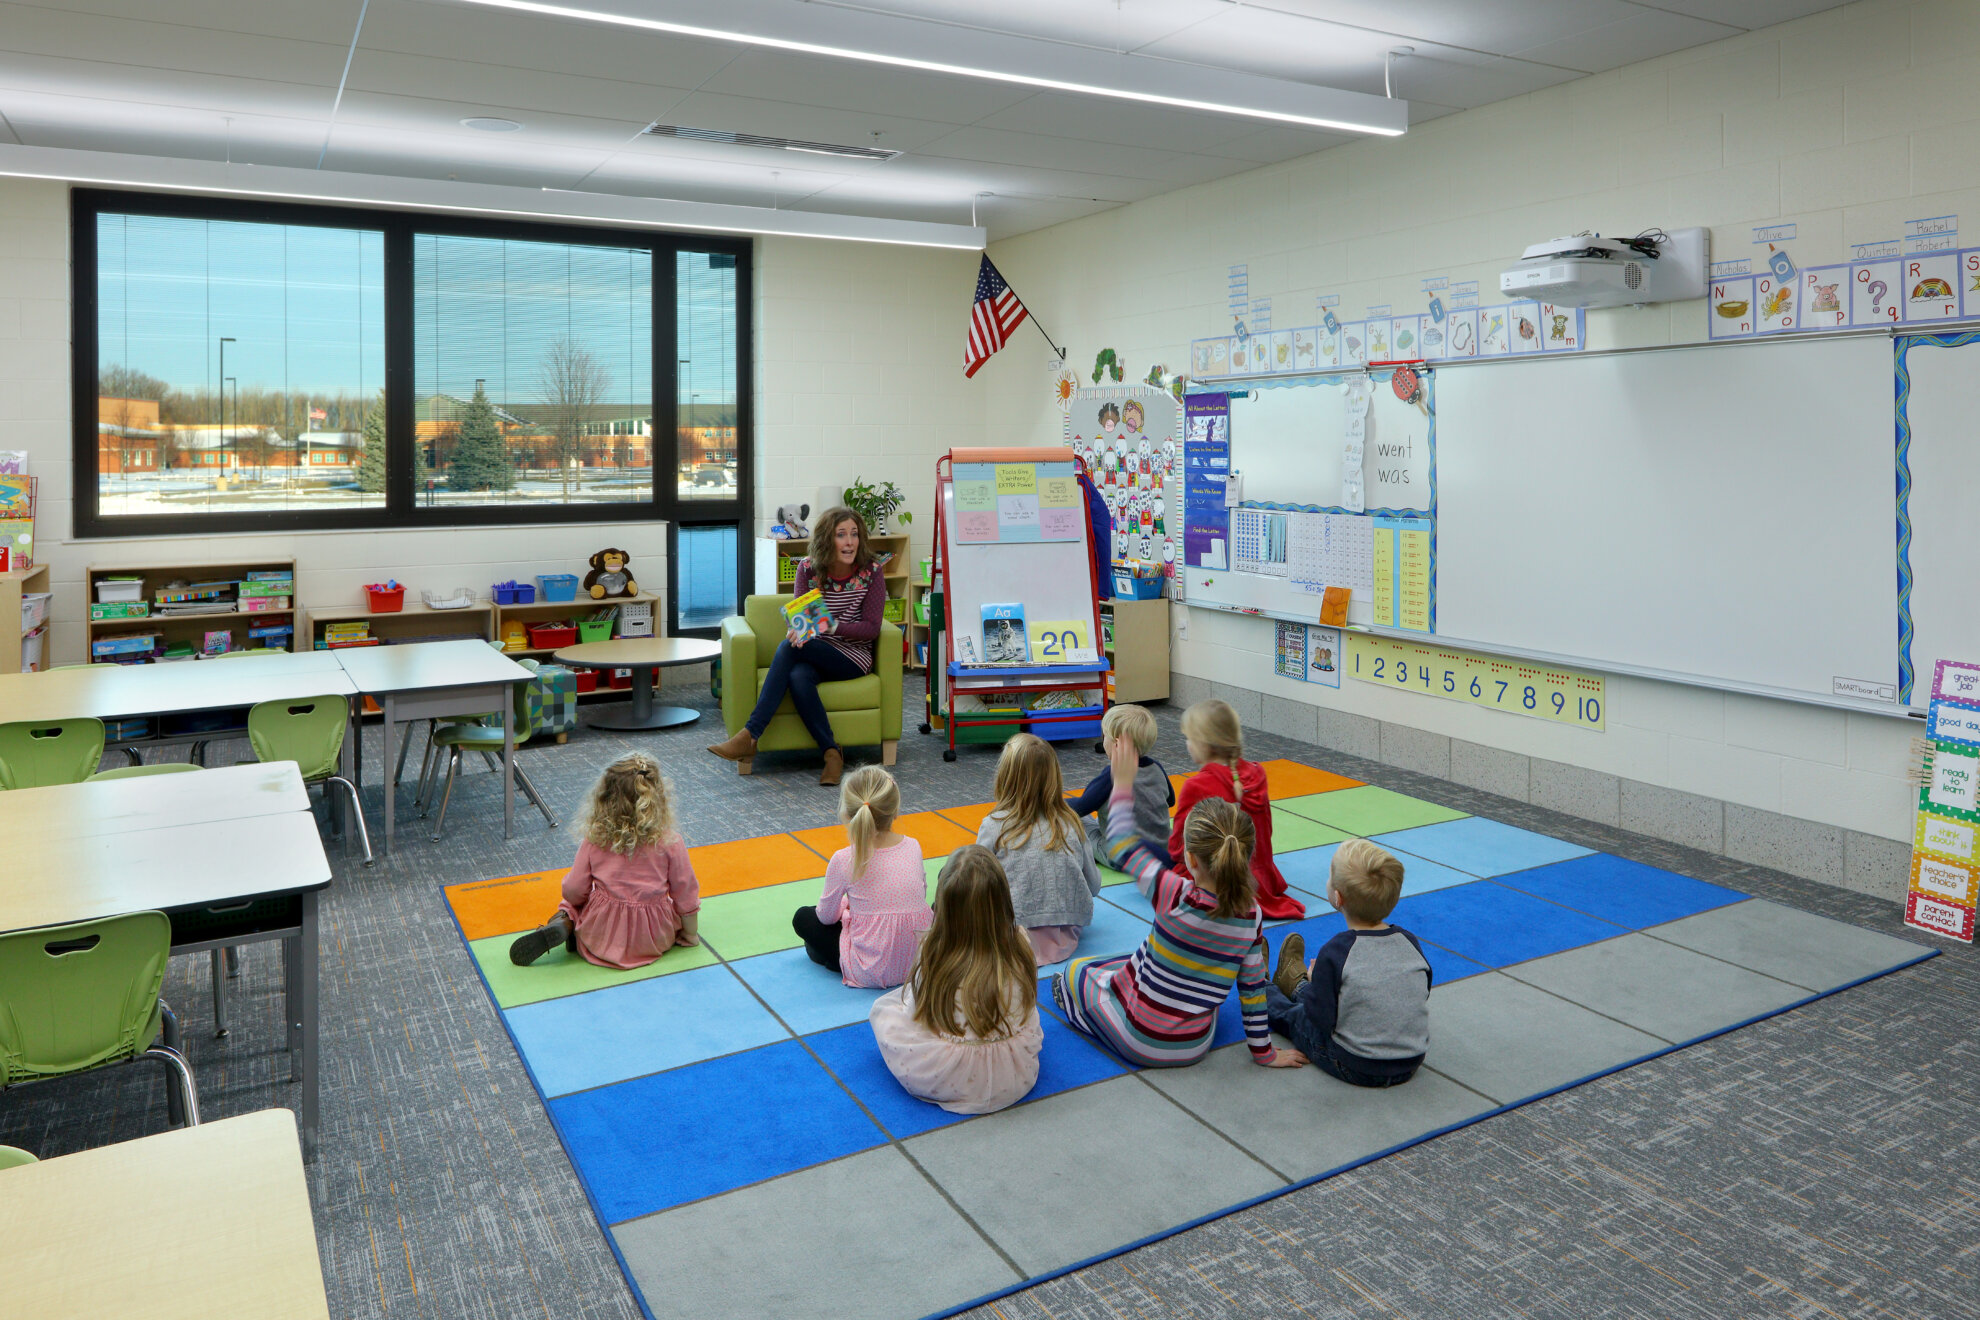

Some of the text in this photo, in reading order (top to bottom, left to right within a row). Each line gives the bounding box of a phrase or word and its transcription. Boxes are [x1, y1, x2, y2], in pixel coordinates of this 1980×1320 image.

[1917, 219, 1949, 235] Rachel
[1758, 229, 1782, 241] Olive
[1916, 236, 1951, 251] Robert
[1857, 243, 1898, 259] Quinten
[1716, 261, 1748, 276] Nicholas
[1910, 262, 1921, 277] R
[1967, 256, 1980, 271] S
[1857, 269, 1871, 283] Q
[1715, 285, 1725, 299] N
[1434, 305, 1440, 317] i
[1544, 305, 1554, 316] M
[1888, 306, 1899, 321] q
[1945, 304, 1954, 315] r
[1327, 318, 1335, 328] e
[1451, 316, 1457, 326] J
[1481, 312, 1487, 322] K
[1741, 322, 1750, 332] n
[1501, 339, 1507, 350] k
[1565, 336, 1575, 345] m
[1378, 434, 1412, 459] went
[1378, 468, 1410, 484] was
[994, 608, 1011, 617] Aa
[1041, 630, 1079, 656] 20
[1953, 674, 1980, 684] great
[1356, 653, 1601, 723] 1 2 3 4 5 6 7 8 9 10
[1939, 717, 1961, 727] good
[1942, 767, 1970, 782] ready
[1950, 776, 1961, 786] to
[1942, 783, 1966, 796] learn
[1928, 833, 1956, 848] about
[1923, 864, 1966, 883] teacher's
[1928, 875, 1958, 889] choice
[1924, 903, 1956, 919] parent
[1920, 911, 1958, 927] contact
